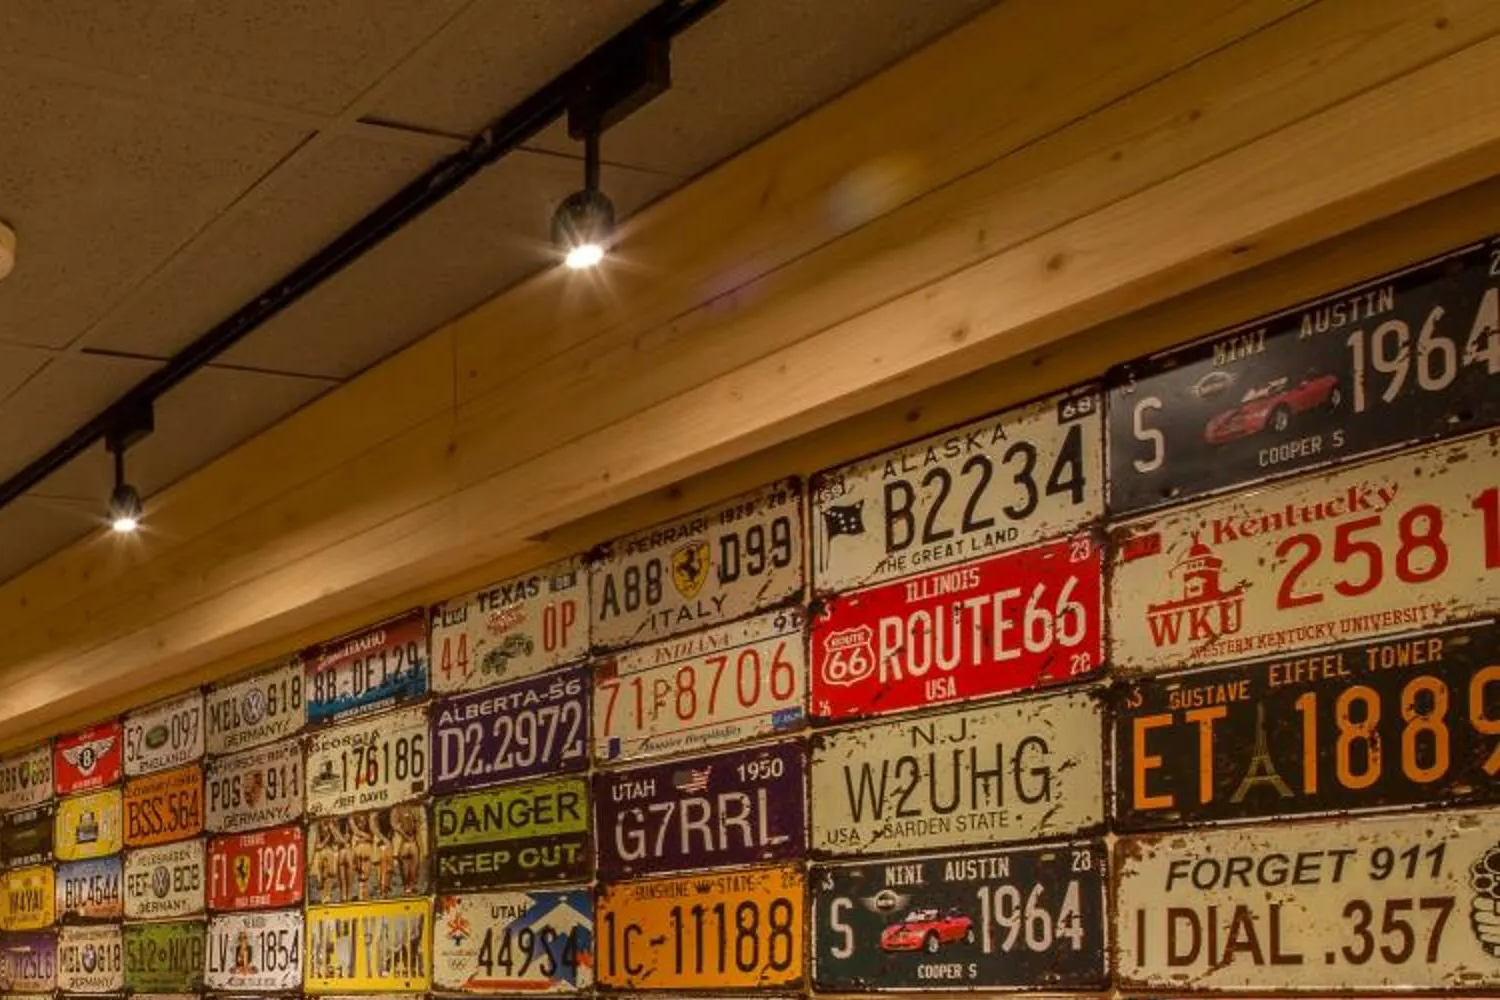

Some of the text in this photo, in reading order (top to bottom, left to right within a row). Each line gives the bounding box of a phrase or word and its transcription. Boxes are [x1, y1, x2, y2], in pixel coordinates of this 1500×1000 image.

[1299, 286, 1395, 339] AUSTIN
[1133, 287, 1500, 473] S 1964
[883, 424, 1008, 480] ALASKA
[1259, 429, 1344, 468] COOPER S
[884, 424, 1086, 553] B2234
[1212, 482, 1399, 544] Kentucky
[601, 516, 791, 620] A88 D99
[875, 528, 1019, 574] THE GREAT LAND
[477, 576, 540, 612] TEXAS
[906, 569, 980, 603] ILLINOIS
[650, 595, 727, 631] ITALY
[1147, 599, 1243, 648] WKU
[1258, 624, 1334, 648] KENTUCKY
[1341, 605, 1445, 632] UNIVERSITY
[441, 633, 468, 680] 44
[654, 635, 730, 662] INDIANA
[830, 632, 866, 646] ROUTE
[829, 648, 868, 677] 66
[1169, 639, 1443, 709] GUSTAVE EIFFEL TOWER
[925, 679, 956, 700] USA
[437, 701, 583, 781] D2.2972
[911, 718, 977, 747] N.J.
[612, 758, 784, 801] UTAH 1950
[844, 735, 1050, 823] W2UHG
[1133, 706, 1227, 810] ET
[211, 775, 240, 812] POS
[266, 764, 298, 800] 911
[439, 792, 580, 836] DANGER
[615, 788, 789, 861] G7RRL
[827, 811, 1008, 844] USA STATE
[257, 844, 297, 892] 1929
[440, 844, 580, 875] KEEP OUT
[885, 857, 1009, 885] MINI AUSTIN
[1166, 843, 1447, 891] FORGET 911
[492, 901, 527, 919] UTAH
[830, 881, 1084, 959] S 1964
[1136, 896, 1455, 967] I DIAL .357
[209, 929, 298, 972] LV 1854
[918, 964, 977, 979] COOPER S
